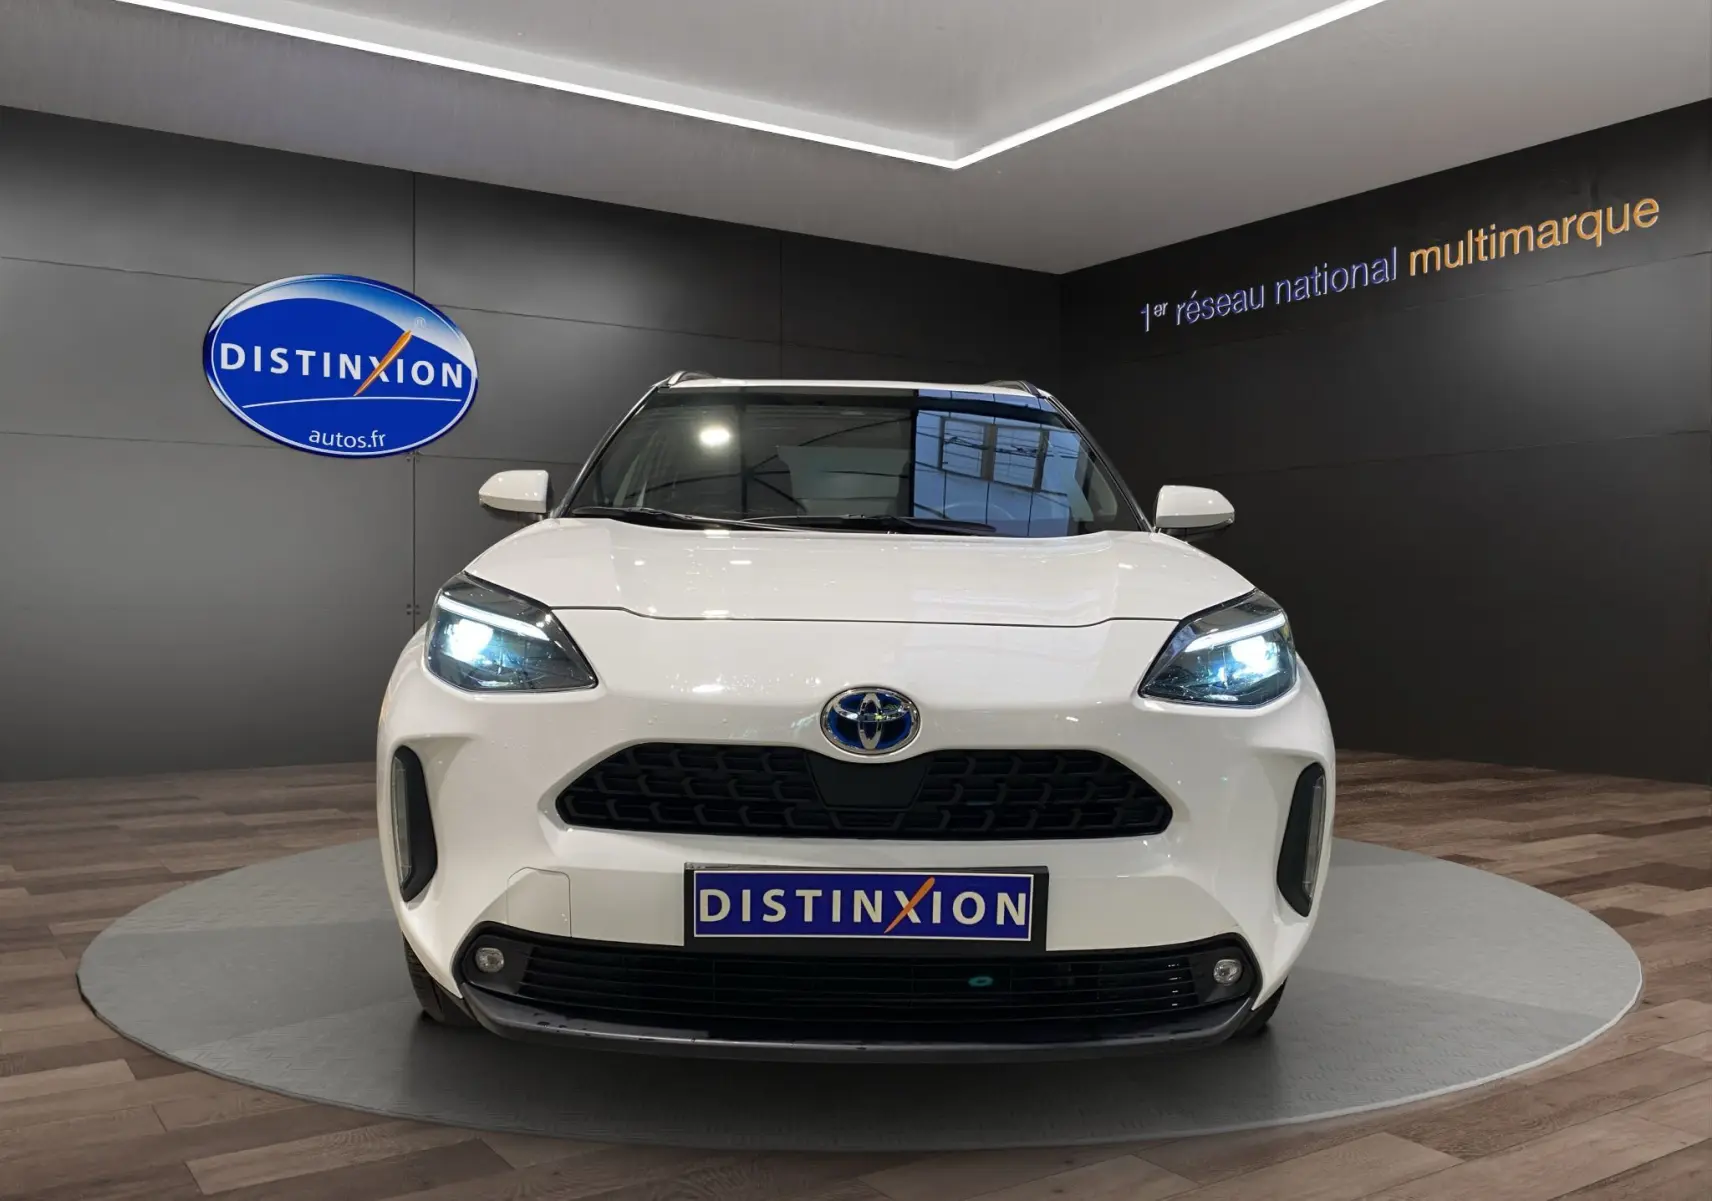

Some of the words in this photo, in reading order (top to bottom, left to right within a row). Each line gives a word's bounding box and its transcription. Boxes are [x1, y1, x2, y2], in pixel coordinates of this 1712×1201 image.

[1175, 290, 1265, 325] réseau
[1274, 246, 1398, 305] national
[1409, 198, 1660, 276] multimarque
[220, 331, 463, 396] DISTINXION
[308, 429, 386, 448] autos.fr
[699, 877, 1027, 933] DISTINXION
